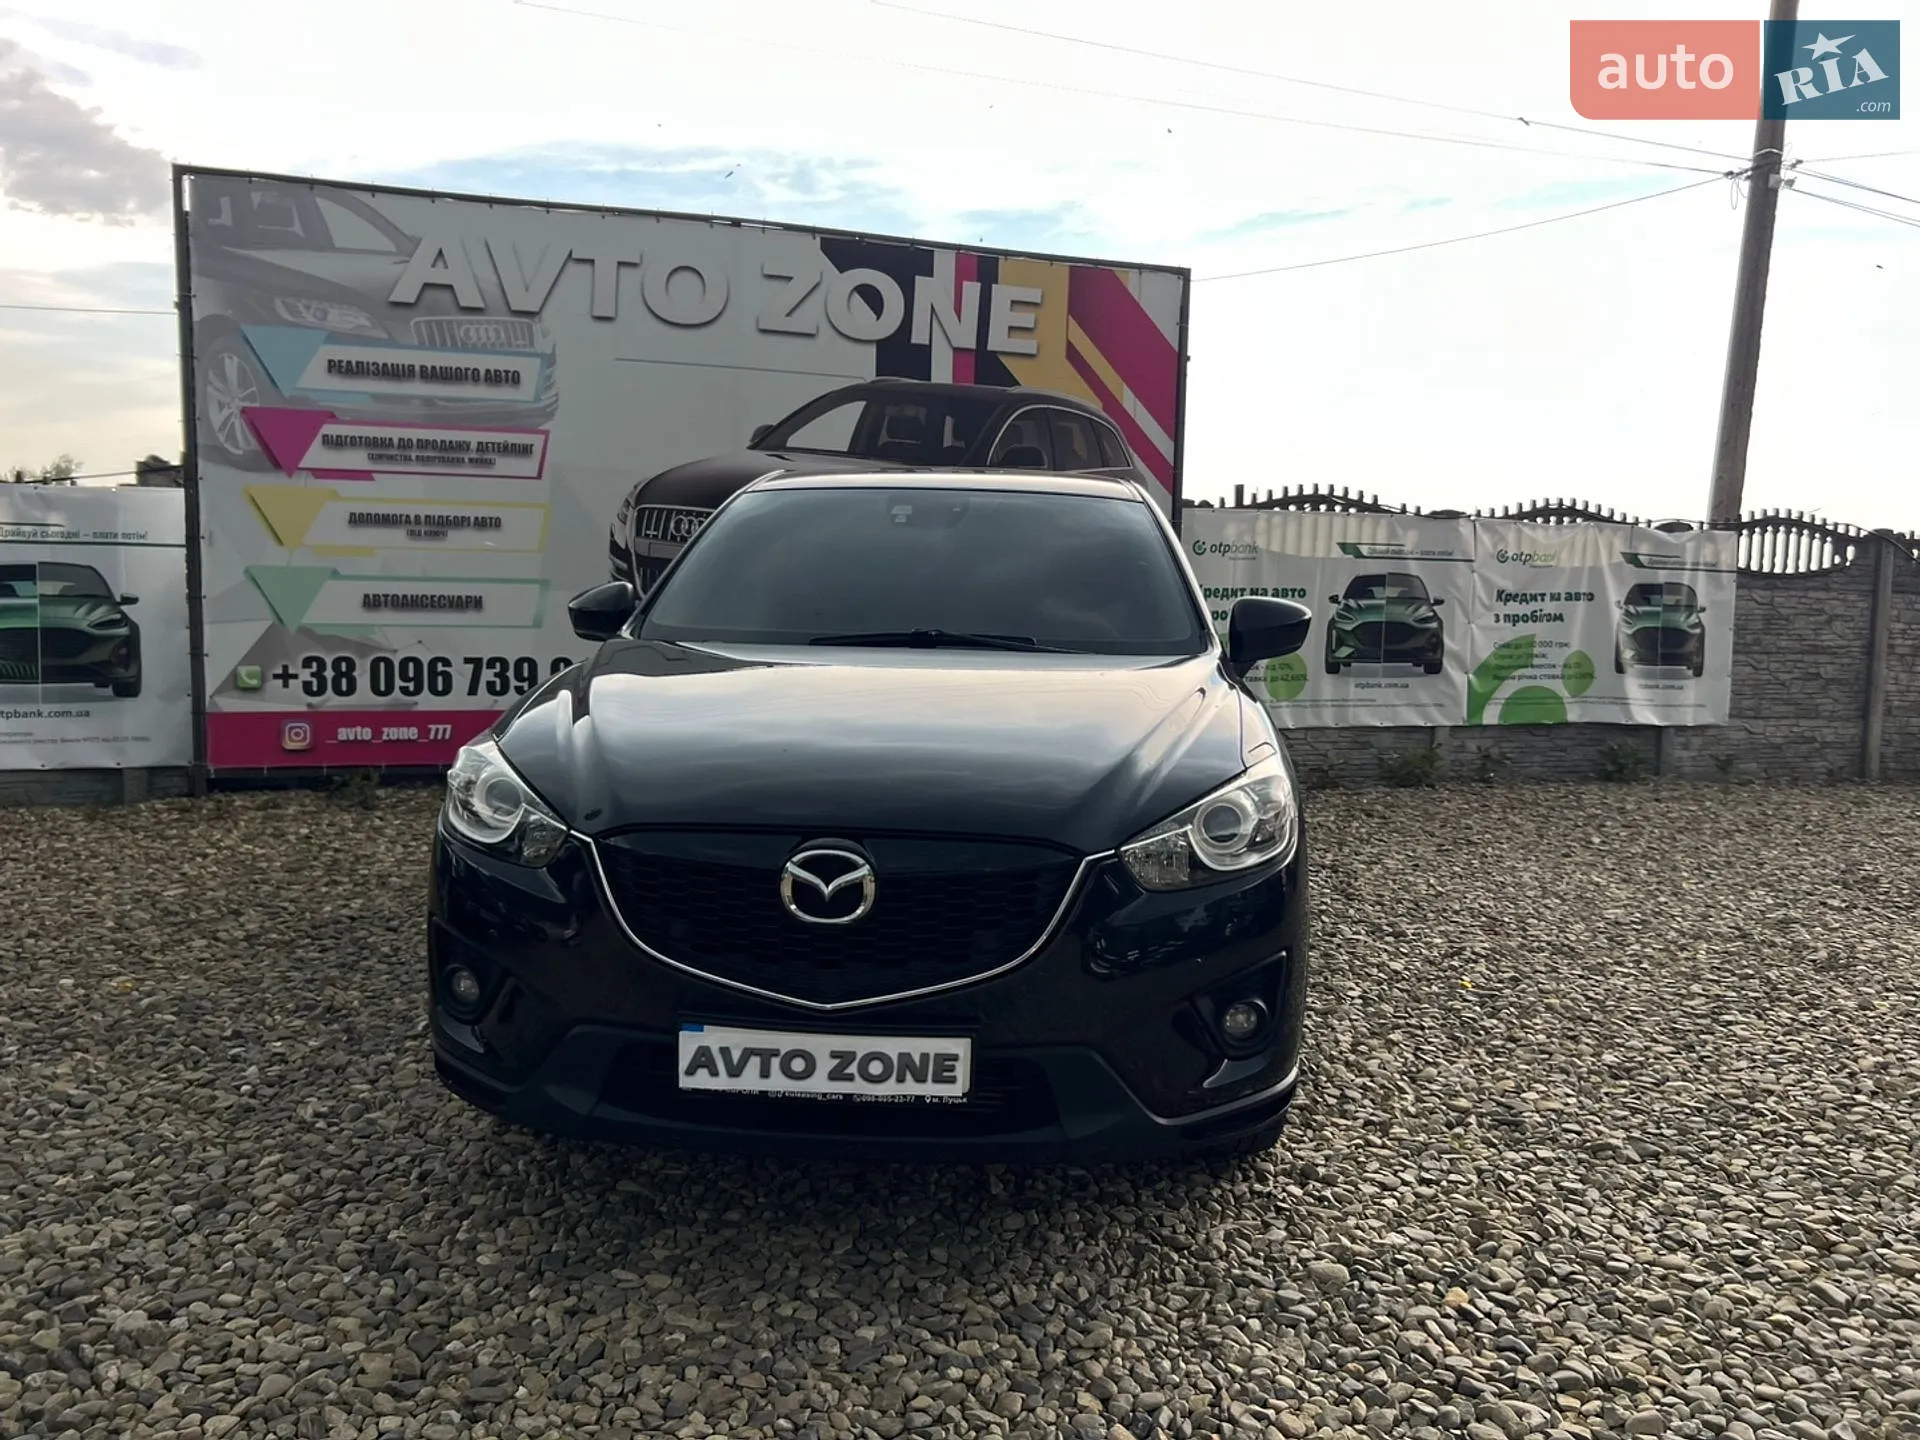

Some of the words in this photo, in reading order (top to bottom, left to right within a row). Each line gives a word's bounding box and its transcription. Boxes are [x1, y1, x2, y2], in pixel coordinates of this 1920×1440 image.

[387, 235, 730, 327] AVTO
[756, 262, 1044, 356] ZONE
[327, 358, 416, 381] РЕАЛІЗАЦІЯ
[419, 364, 481, 383] ВАШОГО
[484, 368, 521, 385] АВТО
[321, 433, 395, 450] ПІДГОТОВКА
[397, 438, 414, 451] ДО
[476, 440, 535, 456] ДЕТЕЙЛІНГ
[348, 511, 413, 527] ДОПОМОГА
[414, 513, 422, 526] В
[424, 514, 471, 528] ПІДБОРІ
[473, 515, 503, 529] АВТО
[1209, 540, 1260, 557] otpbank
[362, 592, 484, 611] АВТОАКСЕСУАРИ
[1199, 584, 1247, 600] редит
[1271, 587, 1307, 599] авто
[1495, 589, 1547, 606] Кредит
[1564, 591, 1595, 602] авто
[1503, 608, 1565, 627] пробігом
[272, 655, 357, 697] +38
[369, 655, 453, 697] 096
[463, 656, 538, 696] 739
[685, 1045, 817, 1081] AVTO
[827, 1050, 960, 1084] ZONE
